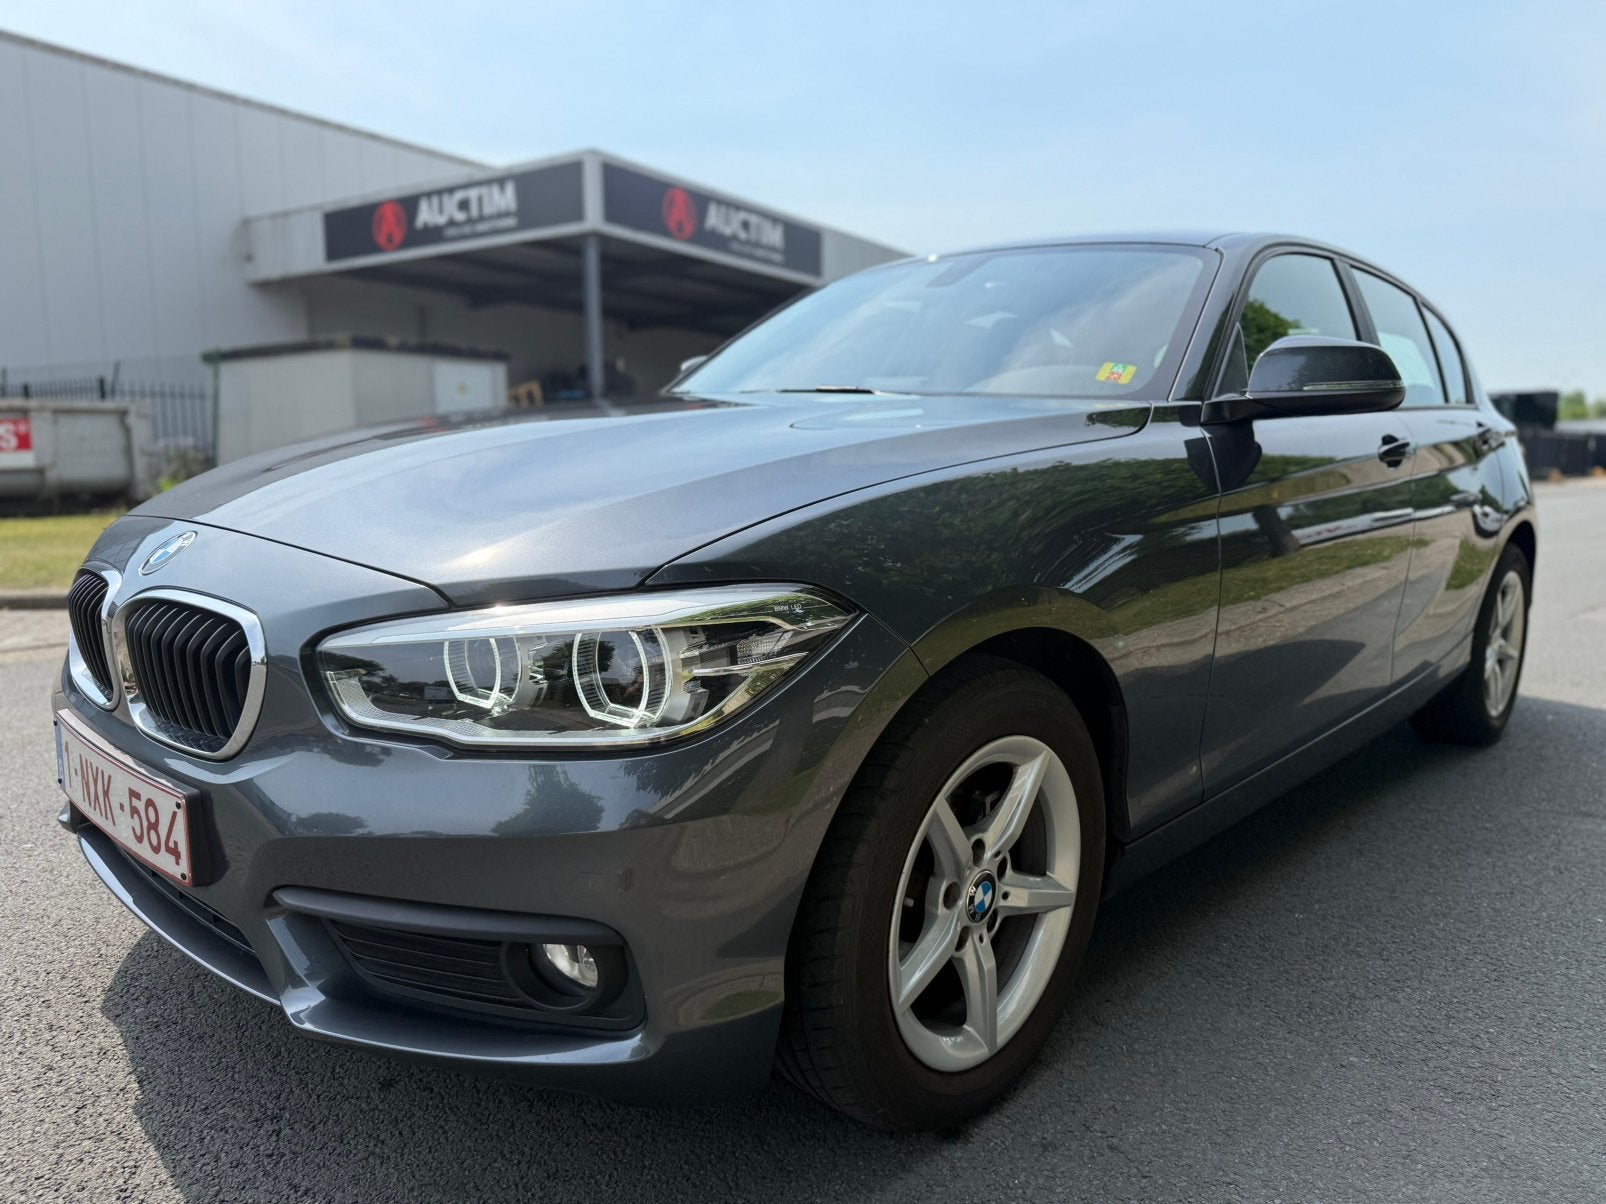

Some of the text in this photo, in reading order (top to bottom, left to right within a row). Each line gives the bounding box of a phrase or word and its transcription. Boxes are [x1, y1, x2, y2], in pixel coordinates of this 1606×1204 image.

[414, 179, 518, 230] AUCTIM
[704, 201, 784, 250] AUCTIM
[774, 603, 802, 612] BMW LED
[64, 741, 182, 867] 1-NXK-584
